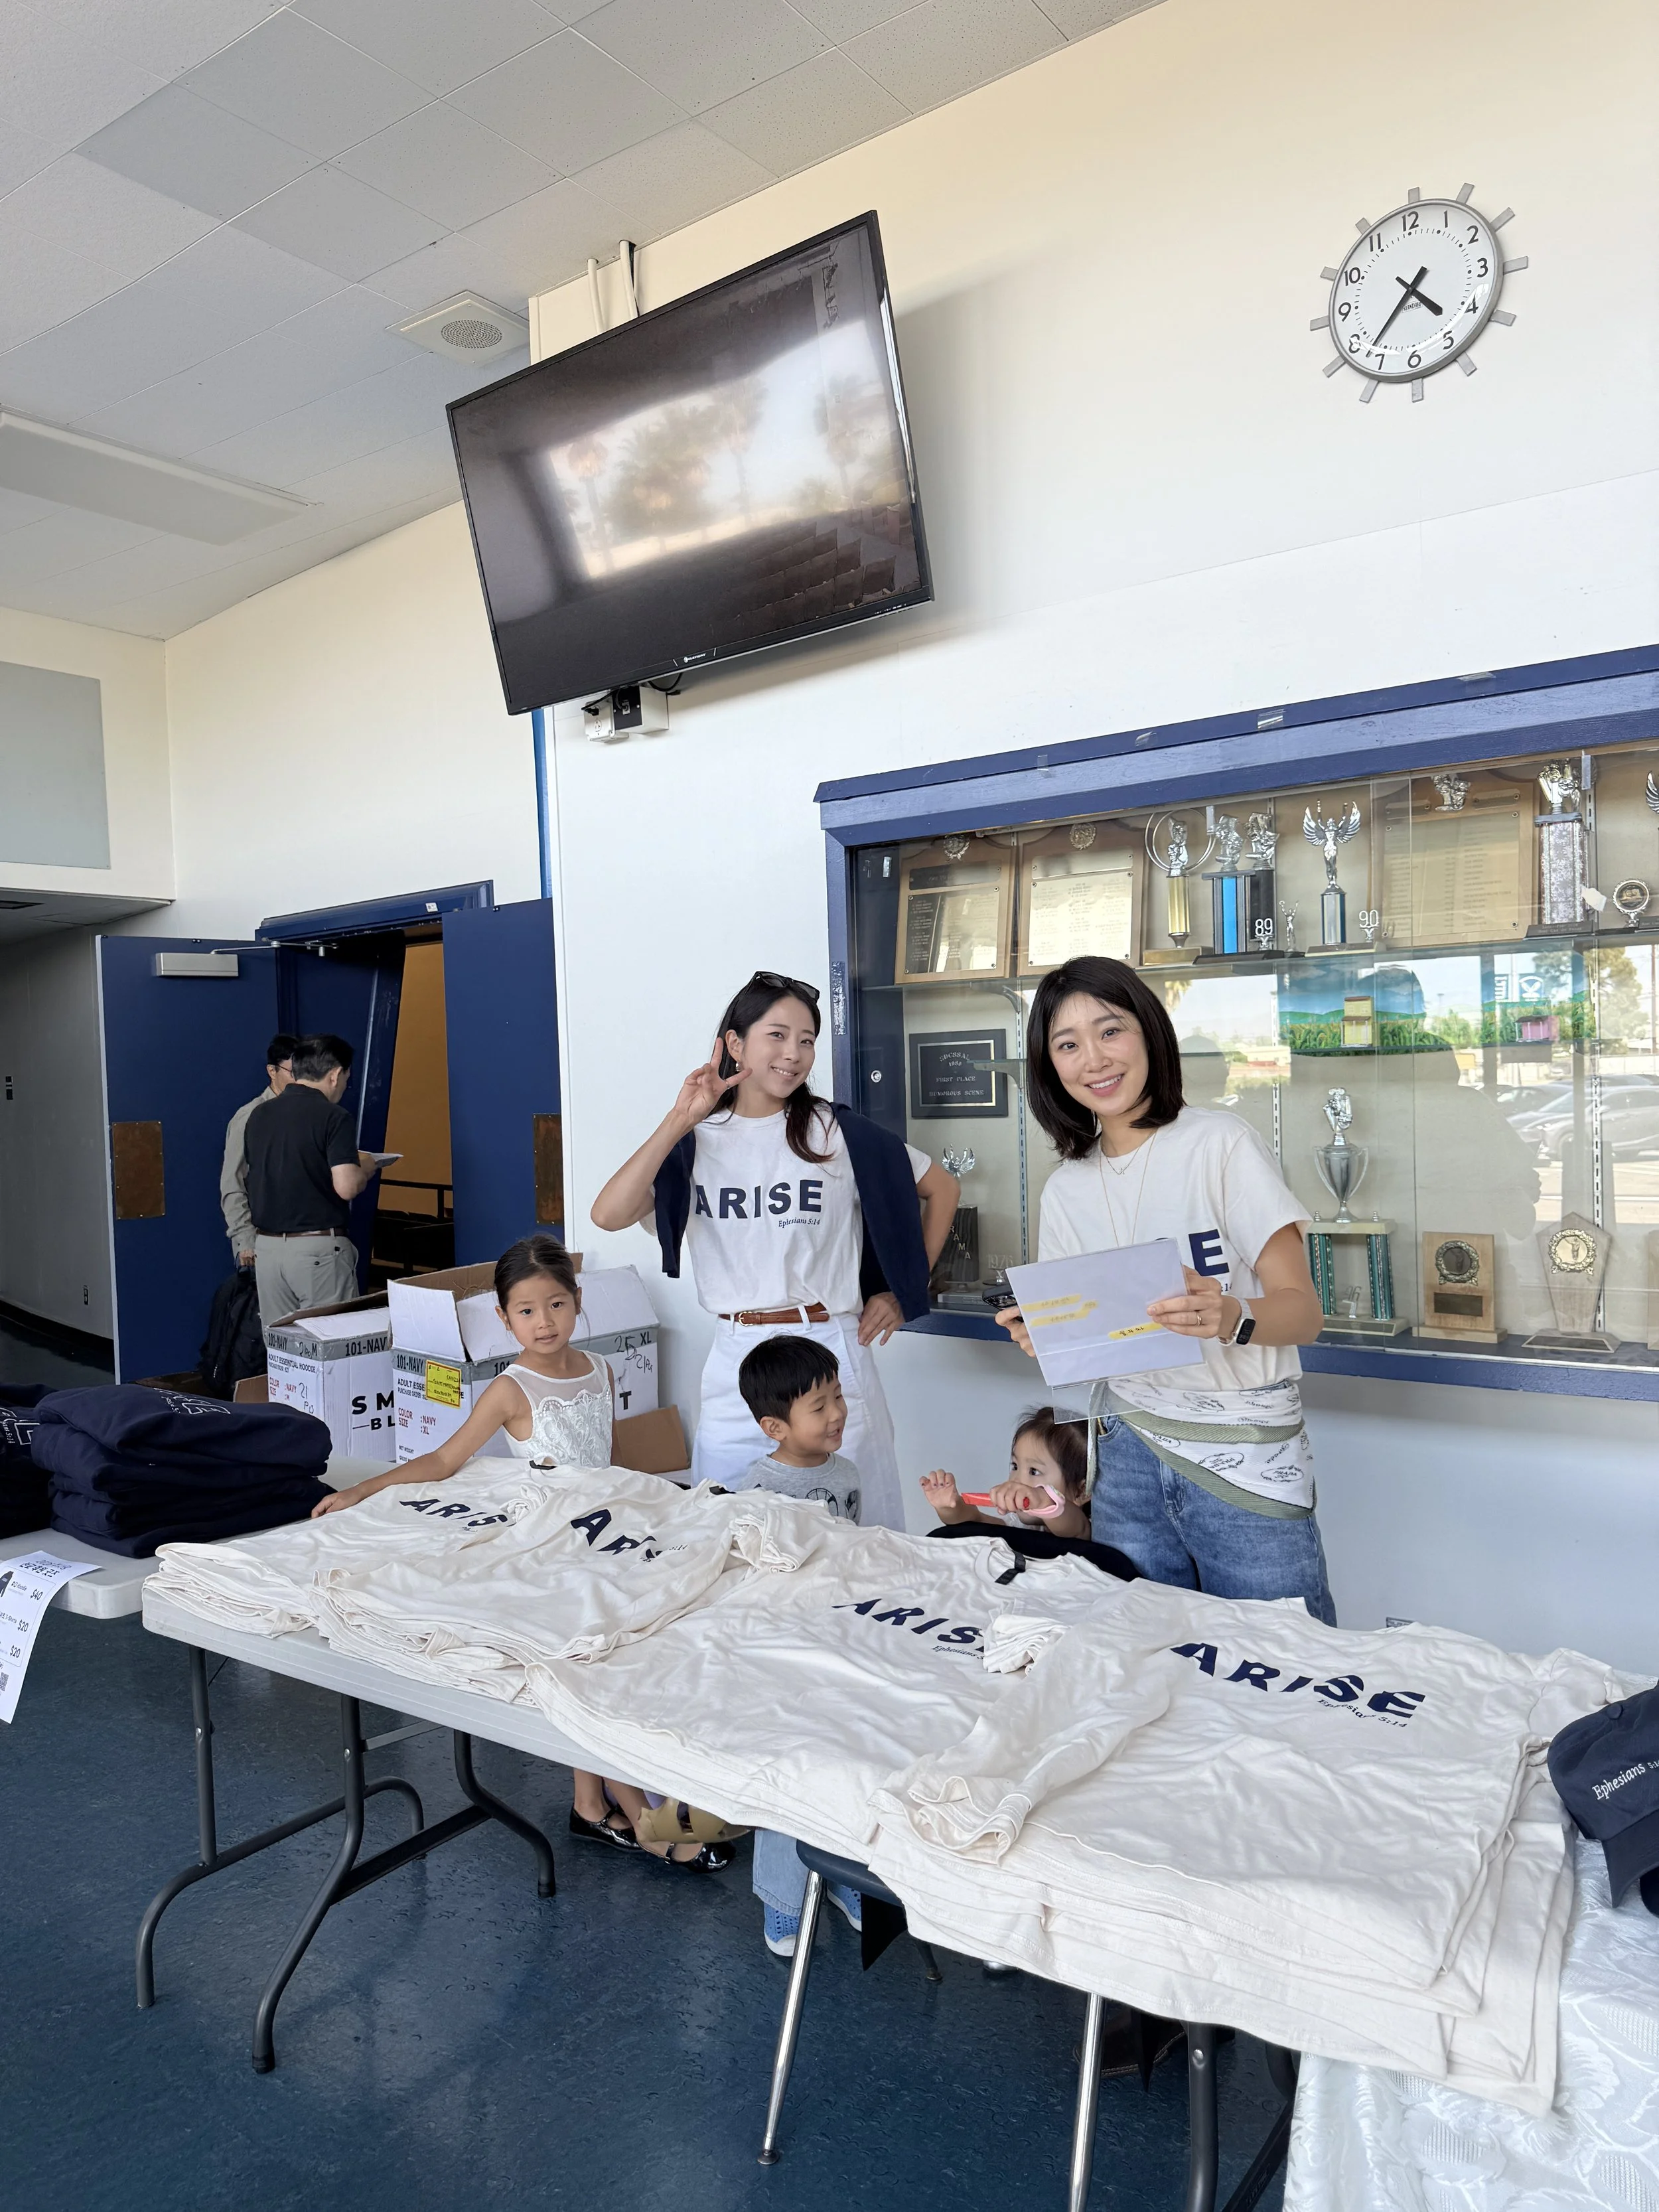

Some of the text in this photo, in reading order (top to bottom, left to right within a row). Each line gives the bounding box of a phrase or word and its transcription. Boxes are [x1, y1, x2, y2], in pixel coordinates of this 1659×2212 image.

[1402, 211, 1419, 232] 12
[1443, 210, 1449, 228] 1
[1369, 233, 1382, 252] 11
[1467, 225, 1479, 245] 2
[1344, 267, 1361, 286] 10
[1477, 258, 1489, 277] 3
[1338, 302, 1352, 322] 9
[1465, 297, 1479, 315] 4
[1348, 334, 1361, 354] 8
[1443, 331, 1455, 350] 5
[1375, 353, 1386, 370] 7
[1407, 349, 1421, 368] 6
[1256, 918, 1273, 936] 89
[1359, 910, 1379, 928] 90
[695, 1179, 824, 1219] ARISE
[268, 1333, 288, 1351] 101-NAVY
[640, 1331, 652, 1347] XL
[312, 1343, 317, 1357] M
[269, 1354, 279, 1363] ADULT
[279, 1357, 299, 1369] ESSENTIAL
[397, 1354, 423, 1374] 101-NAVY
[269, 1377, 279, 1388] COLOR
[397, 1378, 412, 1388] ADULT
[398, 1407, 413, 1420] COLOR
[398, 1418, 409, 1428] SIZE
[399, 1498, 509, 1528] ARIS
[31, 1588, 43, 1601] $40
[17, 1619, 29, 1633] $20
[831, 1598, 984, 1653] ARIS
[9, 1645, 21, 1659] $20
[932, 1645, 977, 1657] Ephesians
[1170, 1643, 1425, 1719] ARISE
[1378, 1716, 1407, 1728] 5:14
[1592, 1760, 1659, 1801] Ephesians 5:1
